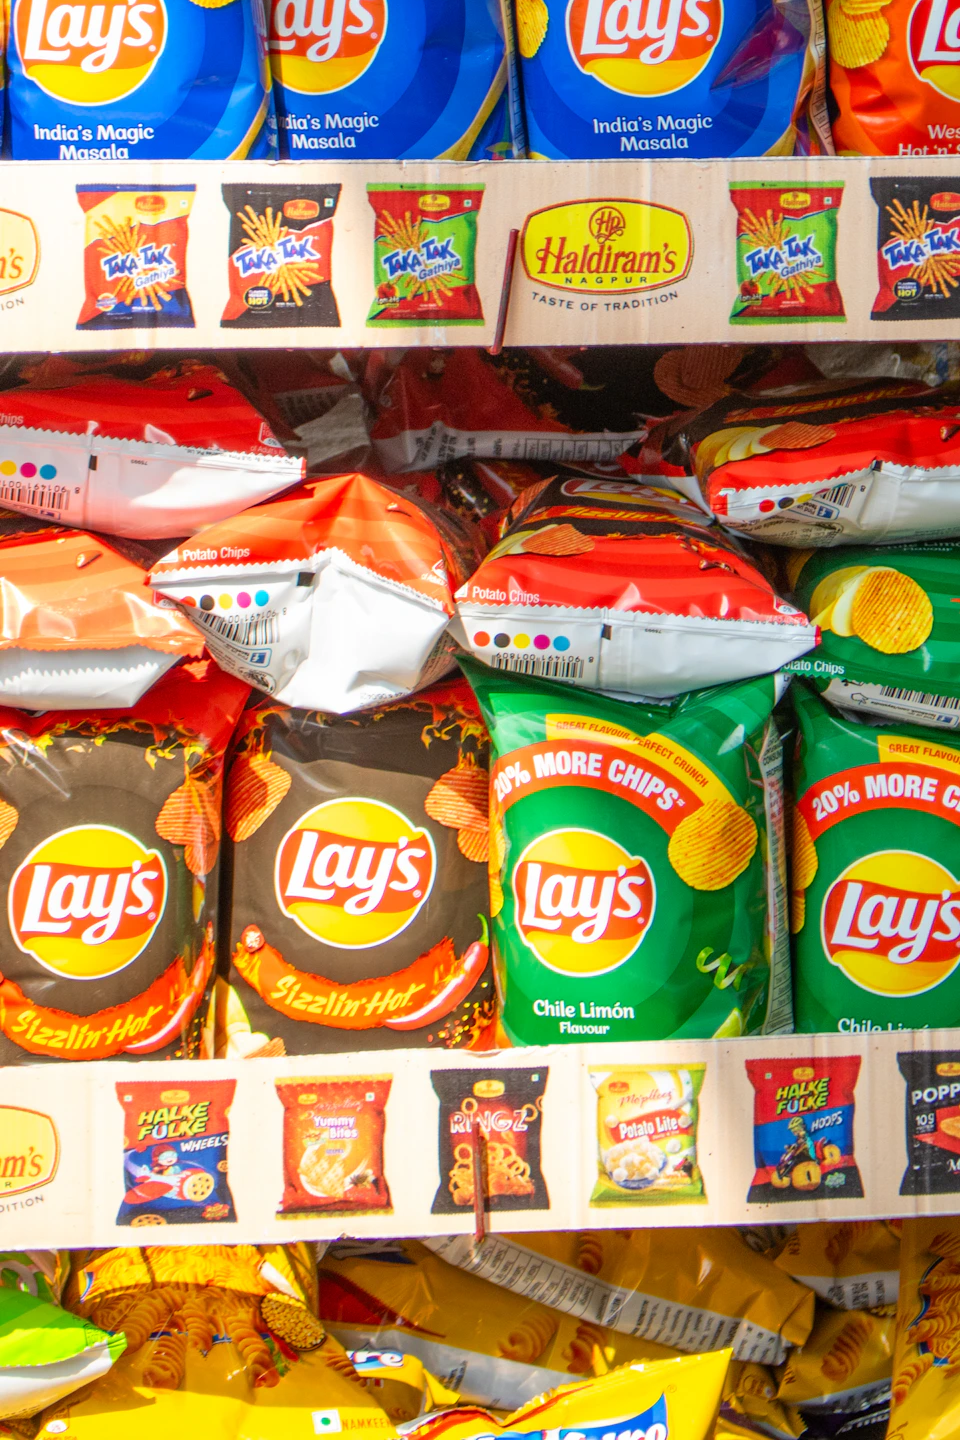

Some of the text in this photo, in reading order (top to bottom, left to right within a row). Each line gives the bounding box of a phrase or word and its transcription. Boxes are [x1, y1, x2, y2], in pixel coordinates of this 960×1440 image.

[33, 122, 154, 145] India's Magic
[592, 114, 714, 135] India's Magic
[59, 144, 129, 160] Masala
[620, 136, 689, 152] Masala
[535, 237, 676, 276] Haldiram's
[564, 276, 648, 285] NAGPUR
[532, 291, 679, 312] TASTE OF TRADITION
[471, 585, 540, 604] Potato Chips
[888, 743, 920, 754] GREAT
[812, 781, 860, 822] 20%
[864, 773, 937, 801] MORE
[285, 832, 427, 915] Lay's
[20, 860, 159, 946] Lay's
[522, 862, 646, 944] Lay's
[533, 999, 634, 1019] Chile Limón
[559, 1021, 610, 1035] Flavour
[775, 1077, 831, 1101] HALKE
[137, 1101, 210, 1126] HALKE
[776, 1091, 829, 1115] FULKE
[137, 1117, 209, 1141] FULKE
[313, 1116, 356, 1129] Yummy
[619, 1116, 678, 1140] Potato Lite
[180, 1134, 229, 1152] WHEELS
